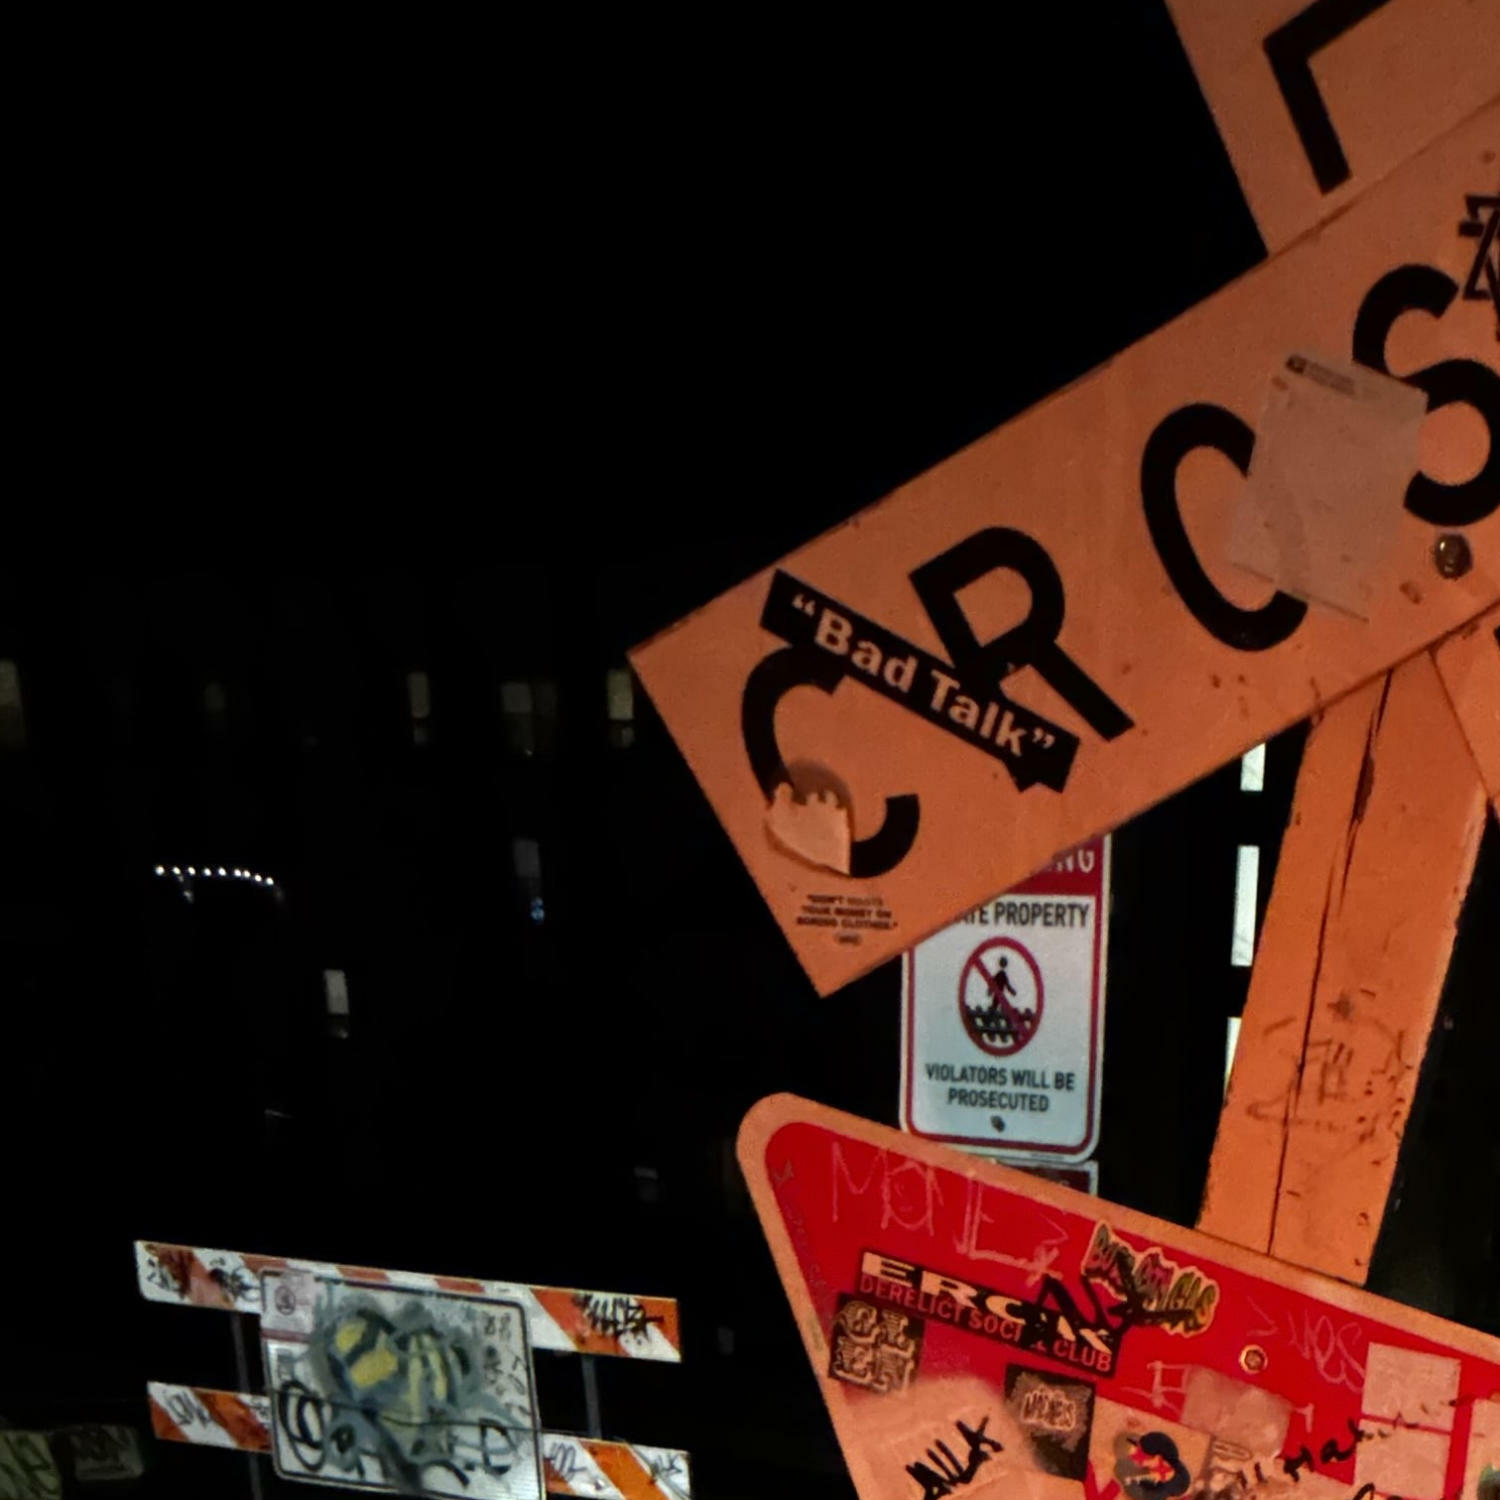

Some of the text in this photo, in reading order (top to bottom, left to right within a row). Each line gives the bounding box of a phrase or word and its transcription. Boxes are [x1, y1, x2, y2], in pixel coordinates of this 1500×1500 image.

[995, 902, 1089, 931] PROPERTY
[925, 1062, 1075, 1092] VIOLATORS WILL BE
[947, 1088, 1050, 1113] PROSECUTED
[860, 1274, 962, 1327] DERELICT
[968, 1307, 1049, 1354] SOCI
[1053, 1337, 1113, 1373] CLUB
